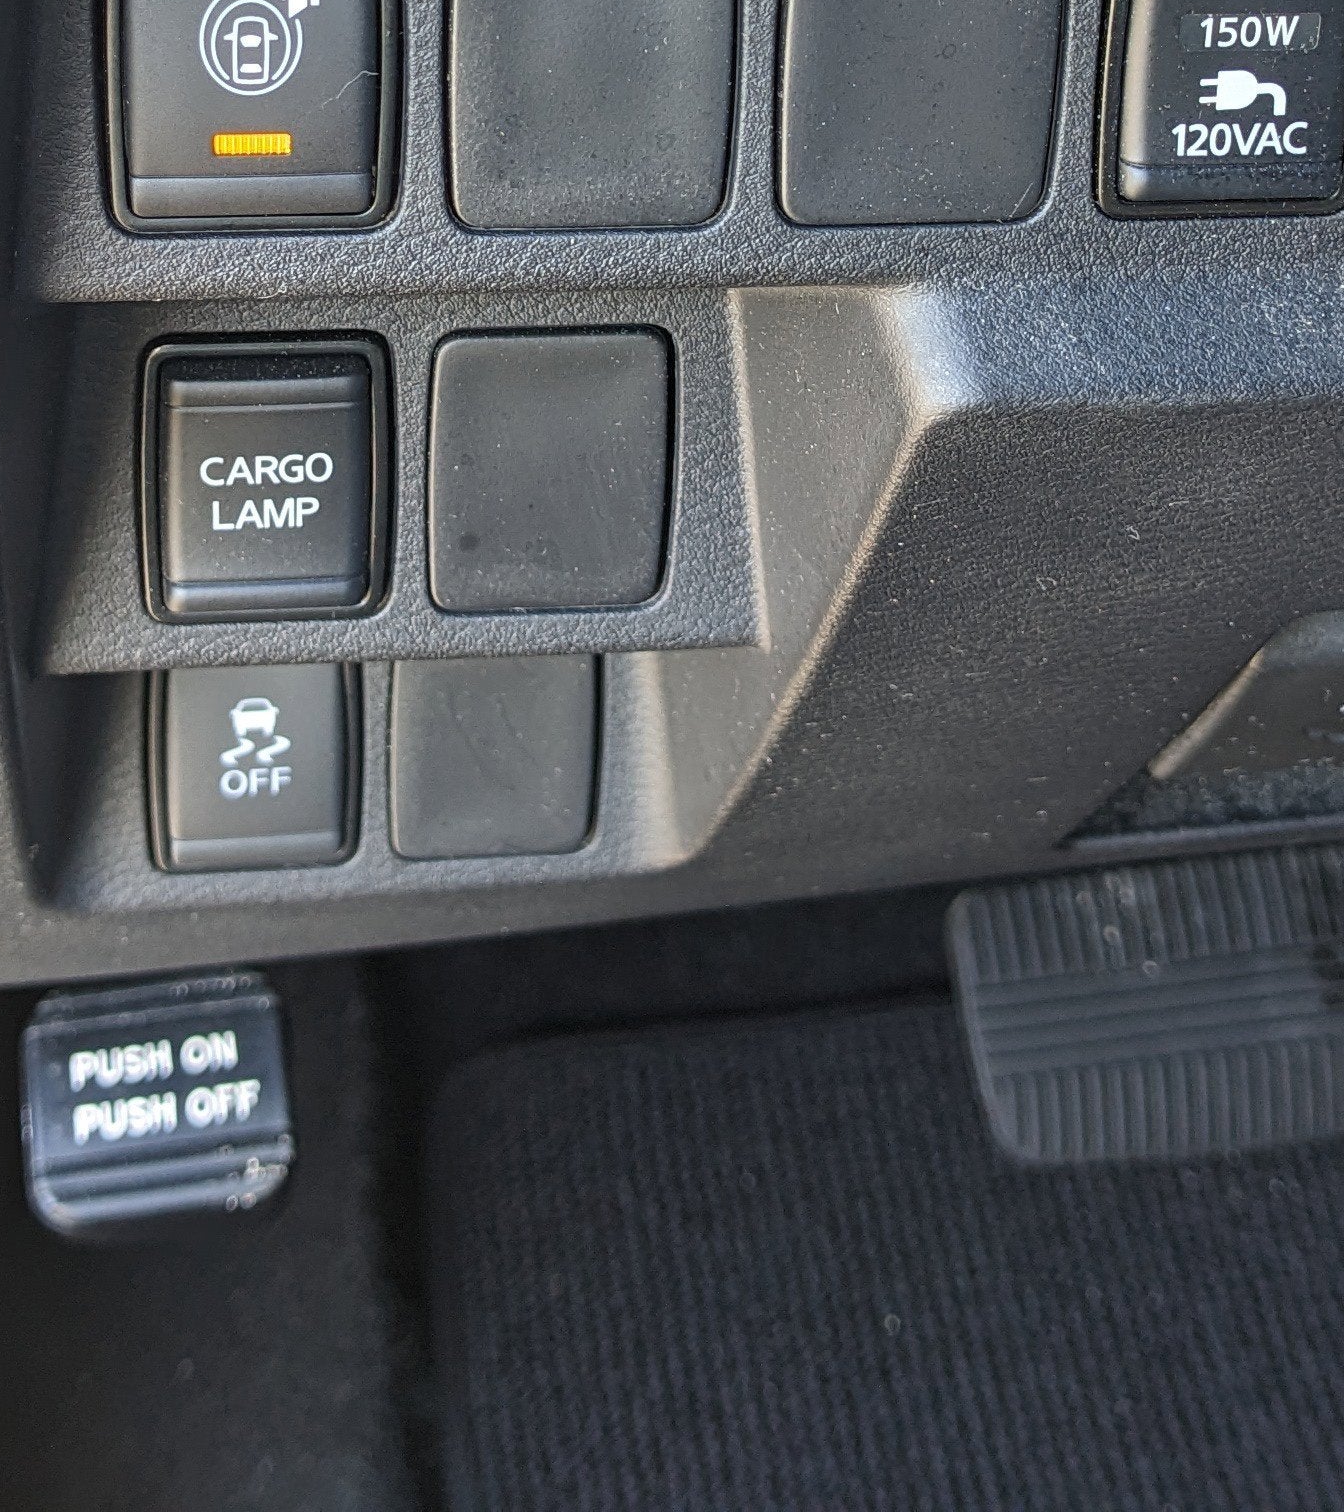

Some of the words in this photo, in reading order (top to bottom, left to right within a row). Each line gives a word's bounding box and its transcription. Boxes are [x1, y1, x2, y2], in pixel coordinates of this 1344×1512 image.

[1199, 14, 1300, 48] 150W
[1170, 120, 1309, 157] 120VAC
[199, 452, 334, 487] CARGO
[211, 496, 321, 531] LAMP
[219, 765, 293, 801] OFF
[68, 1038, 174, 1093] PUSH
[179, 1029, 240, 1076] ON
[72, 1090, 178, 1147] PUSH
[184, 1078, 262, 1129] OFF
